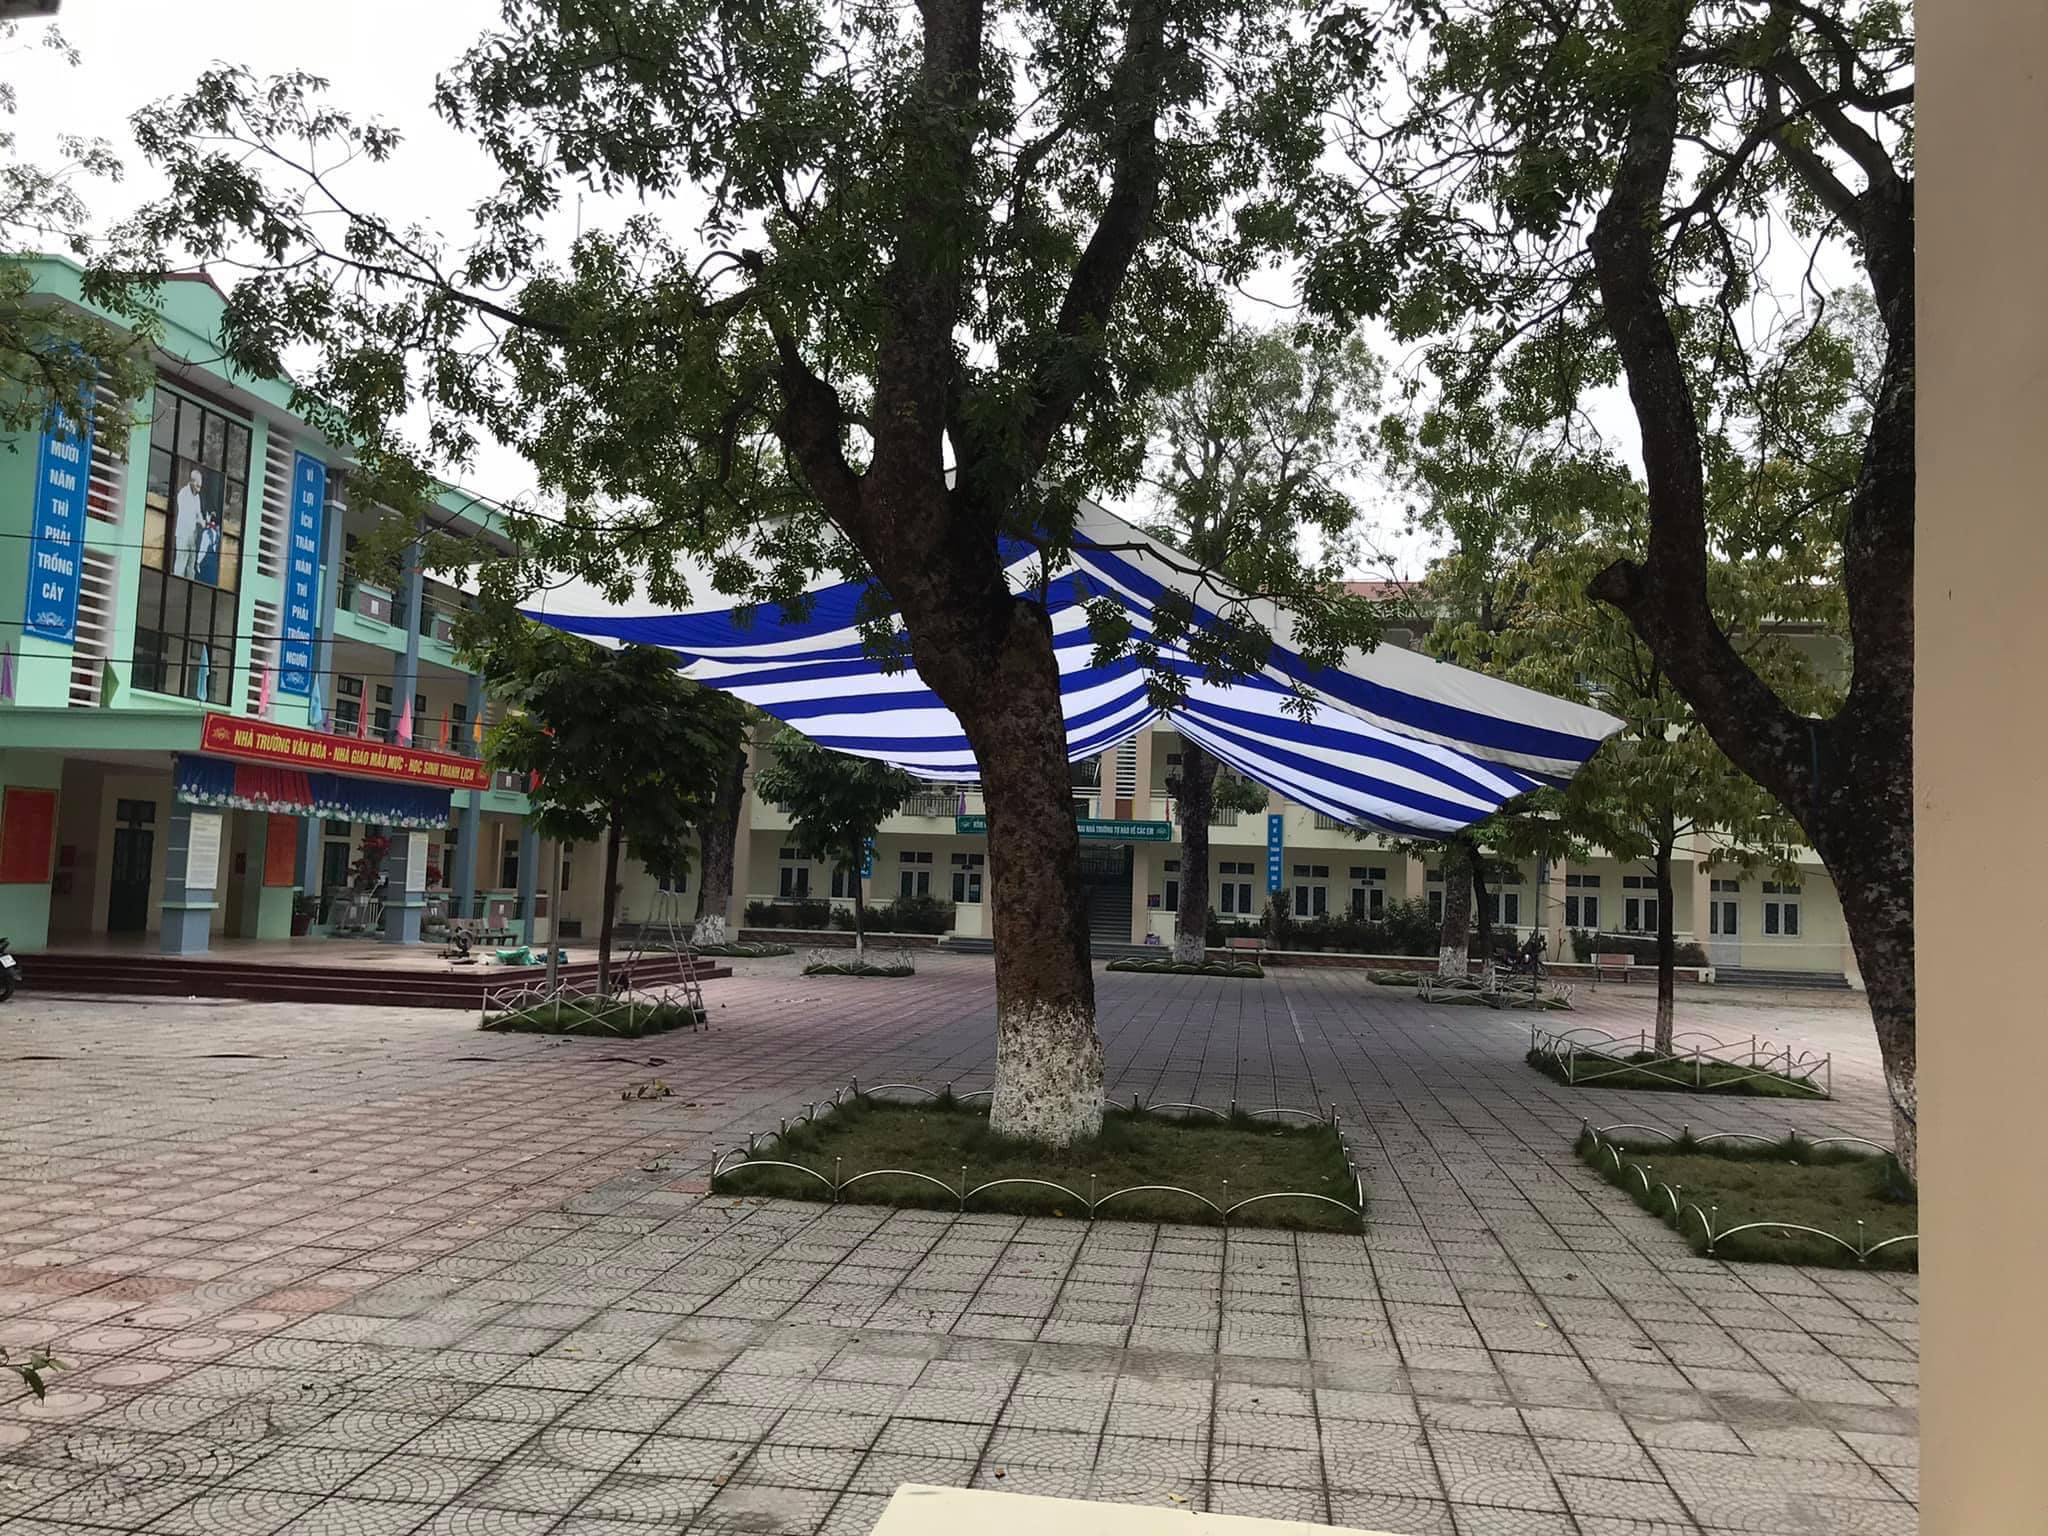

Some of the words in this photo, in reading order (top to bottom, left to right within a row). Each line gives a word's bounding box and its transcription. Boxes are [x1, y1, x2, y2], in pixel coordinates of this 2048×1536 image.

[51, 440, 79, 464] MƯỜI
[50, 469, 76, 491] NĂM
[52, 498, 69, 518] THÌ
[45, 524, 71, 547] PHẢI
[42, 582, 64, 602] CÂY
[292, 603, 309, 621] PHẢI
[234, 728, 254, 748] NHÀ
[256, 732, 291, 754] TRƯỜNG
[292, 737, 309, 757] VĂN
[333, 745, 350, 763] NHÀ
[351, 748, 369, 766] GIÁO
[387, 754, 404, 773] MỰC
[408, 758, 423, 775] HỌC
[423, 760, 440, 776] SINH
[440, 763, 460, 779] THANH
[460, 766, 475, 783] LỊCH
